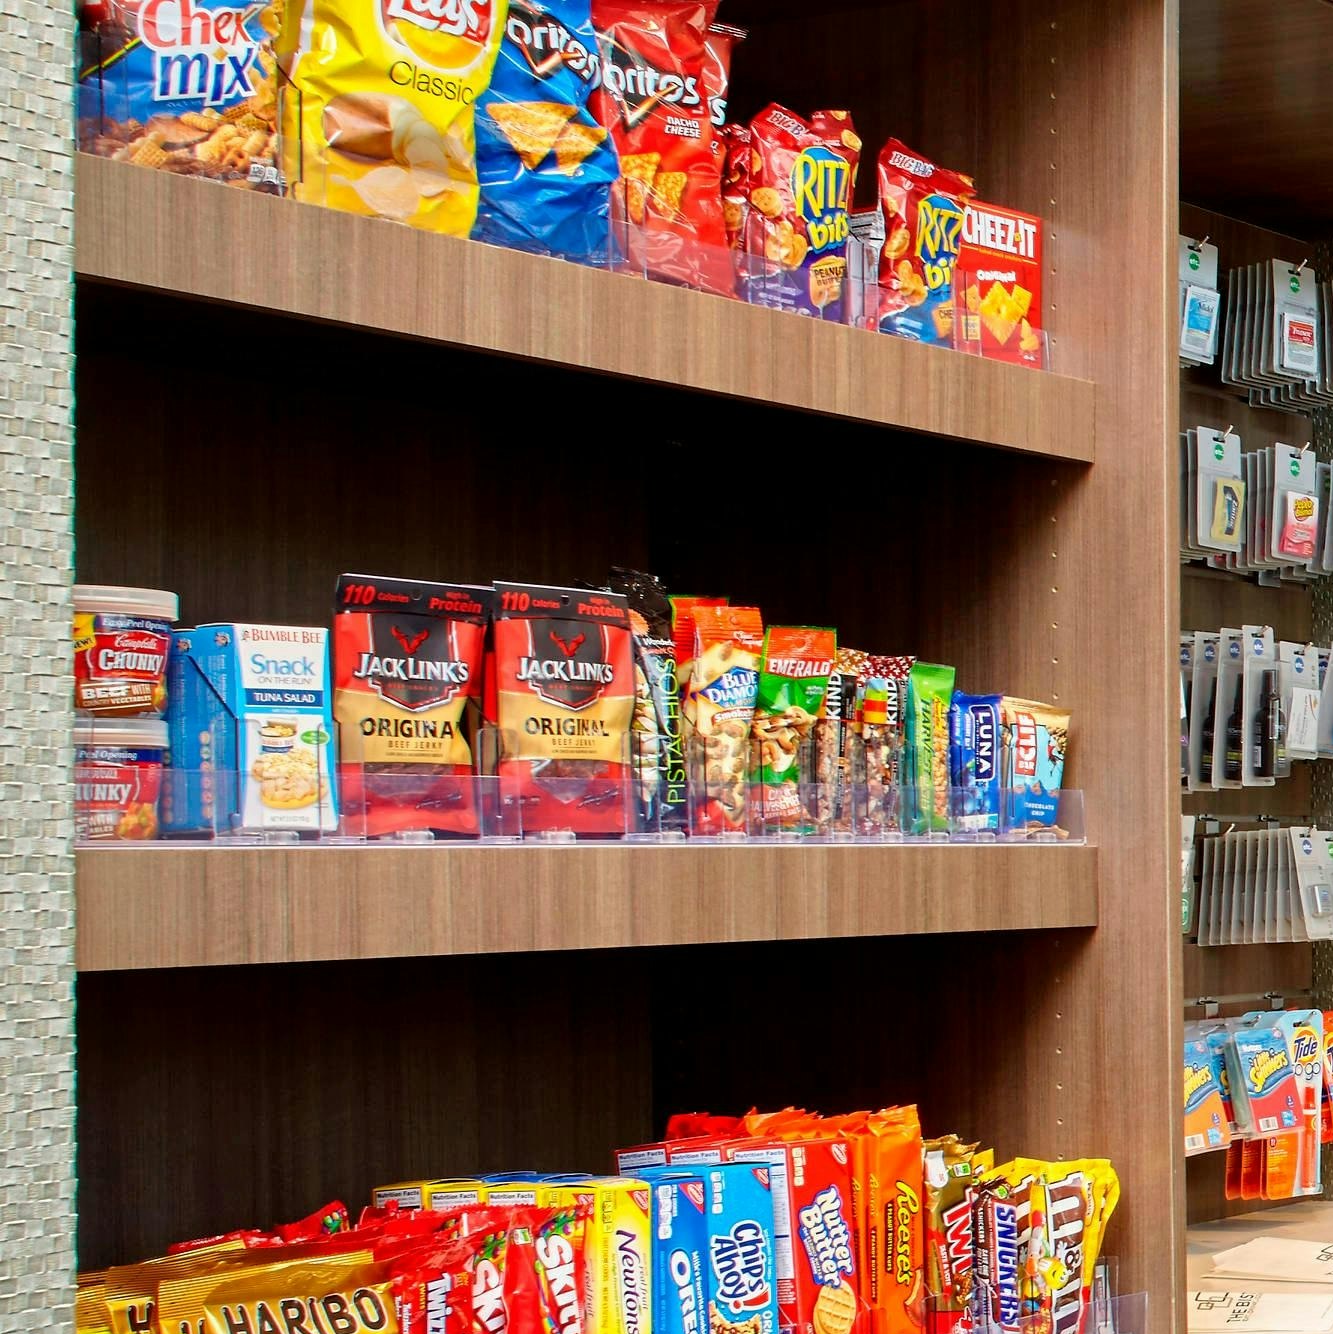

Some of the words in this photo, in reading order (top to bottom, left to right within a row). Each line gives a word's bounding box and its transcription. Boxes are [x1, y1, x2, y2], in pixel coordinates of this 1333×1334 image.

[139, 0, 258, 47] Chex
[506, 16, 602, 92] oritos
[389, 60, 474, 105] Classic
[665, 125, 702, 138] CHEESE
[667, 116, 700, 129] NACHO
[795, 153, 850, 217] RITZ
[915, 200, 965, 259] RITZ
[343, 584, 376, 605] 110
[429, 597, 482, 614] Protein
[501, 591, 530, 612] 110
[578, 603, 625, 618] Protein
[251, 628, 300, 643] BUMBLE
[302, 631, 323, 644] BEE
[98, 648, 164, 675] CHUNKY
[250, 653, 316, 676] Snack
[354, 653, 408, 681] JACK
[516, 657, 570, 682] JACK
[769, 659, 831, 677] EMERALD
[721, 672, 758, 690] BLUE
[253, 692, 283, 702] TUNA
[284, 693, 316, 703] SALAD
[826, 673, 842, 720] KIND
[886, 682, 898, 725] KIND
[360, 717, 461, 739] ORIGINA
[525, 717, 610, 737] ORIGINAL
[656, 657, 687, 804] PISTACHIOS
[1018, 713, 1036, 761] CLIF
[388, 740, 410, 749] BEEF
[414, 741, 443, 750] JERKY
[552, 738, 574, 746] BEEF
[979, 712, 992, 774] LUNA
[1294, 1037, 1318, 1063] Tide
[1305, 1063, 1321, 1080] go
[619, 1151, 647, 1160] Nutrition
[649, 1149, 665, 1157] Facts
[816, 1187, 853, 1275] Nutter
[896, 1181, 919, 1285] Reese's
[733, 1222, 764, 1293] Chips
[799, 1204, 841, 1288] Butter
[995, 1204, 1018, 1327] SNICKERS
[1226, 1308, 1247, 1323] THE
